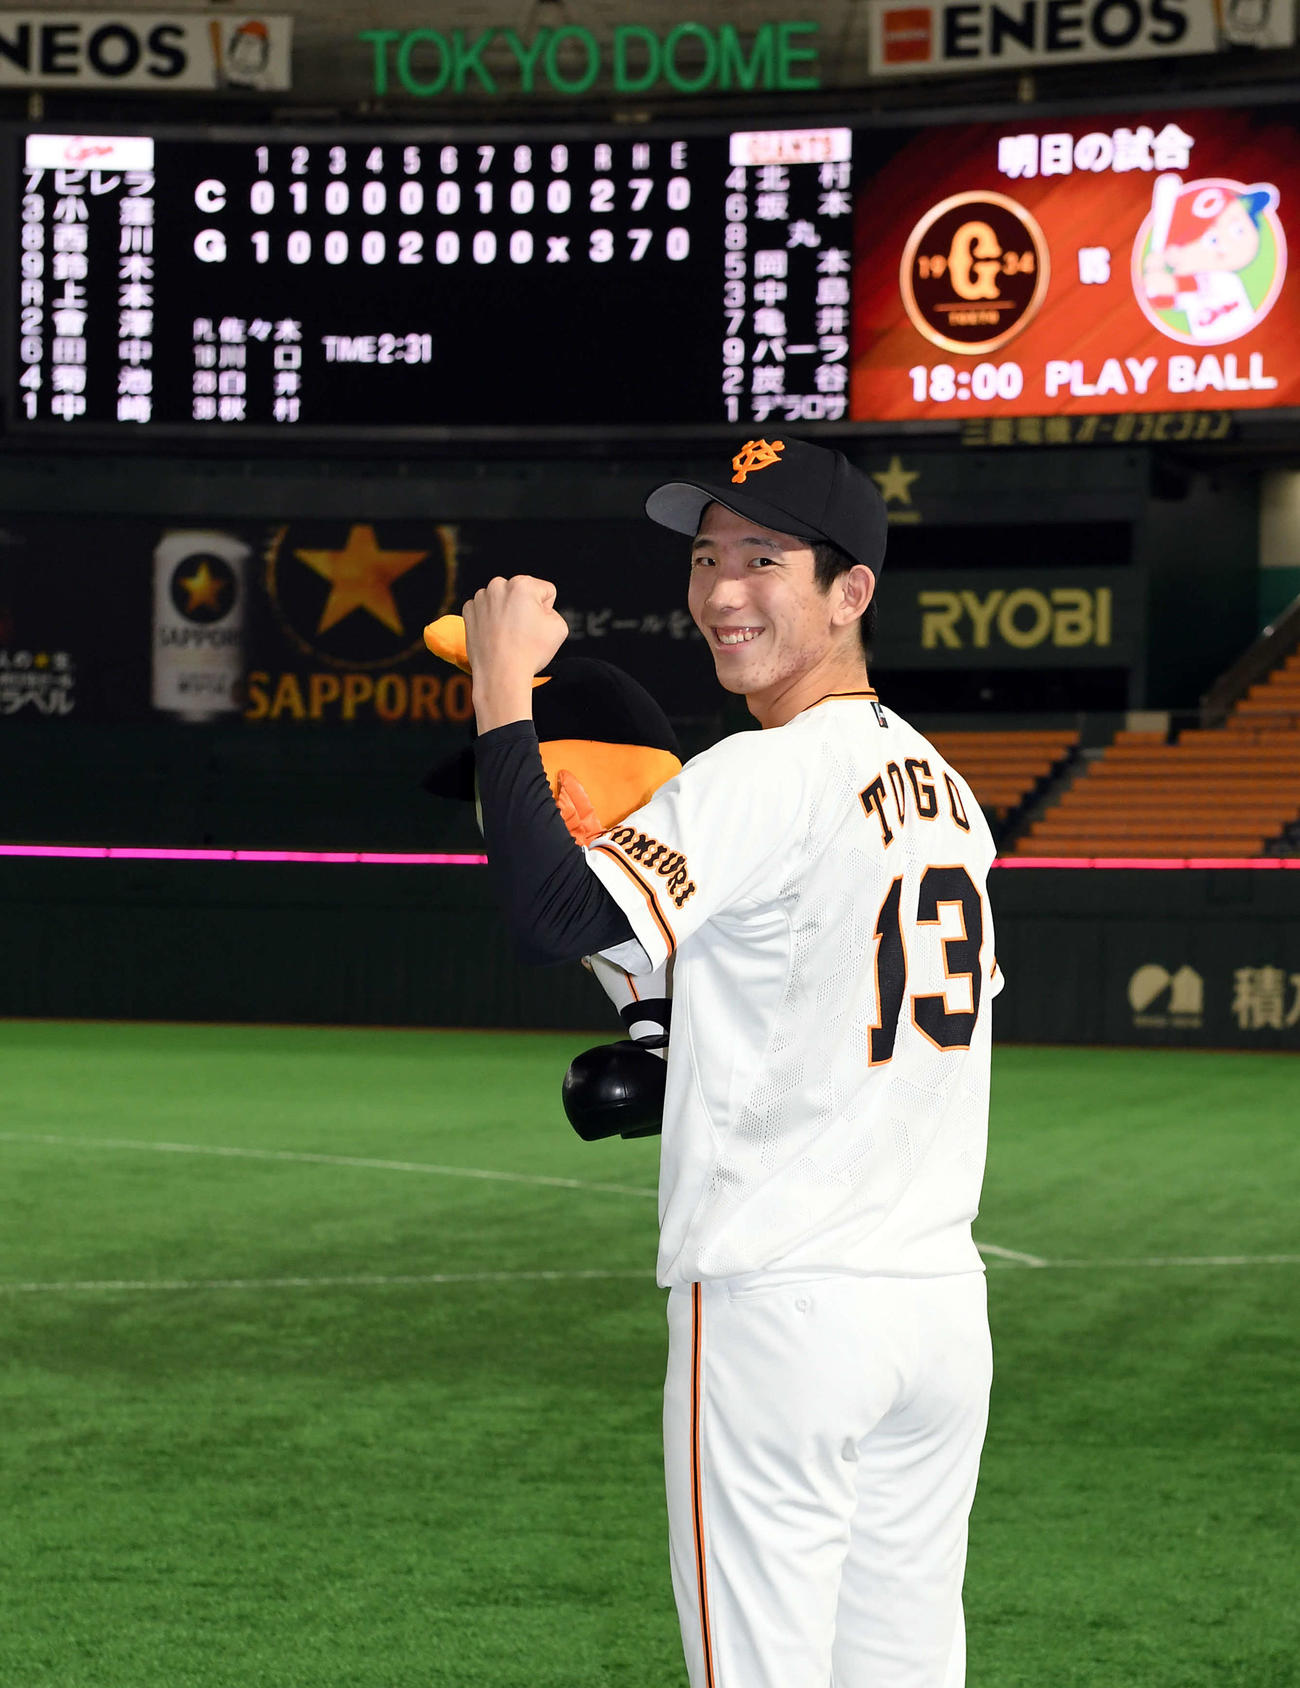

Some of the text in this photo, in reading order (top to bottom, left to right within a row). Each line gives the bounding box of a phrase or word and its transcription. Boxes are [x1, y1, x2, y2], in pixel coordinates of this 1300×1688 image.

[943, 0, 1188, 58] ENEOS
[358, 20, 820, 97] TOKYO DOME
[256, 147, 268, 172] 1
[292, 146, 309, 174] 2
[329, 147, 346, 174] 3
[366, 147, 383, 173] 4
[404, 146, 420, 174] 5
[440, 146, 457, 174] 6
[478, 146, 495, 172] 7
[514, 145, 532, 173] 8
[551, 145, 568, 173] 9
[671, 142, 686, 169] E
[998, 123, 1194, 178] 明日の試合
[725, 167, 747, 192] 4
[22, 193, 44, 222] 3
[195, 177, 690, 215] C 0 1 0 0 0 0 1 0 0 2 7 0
[725, 193, 747, 222] 6
[22, 223, 44, 251] 8
[194, 229, 226, 262] G
[251, 231, 269, 263] 1
[288, 231, 311, 264] 0
[325, 231, 348, 264] 0
[362, 231, 385, 264] 0
[399, 231, 423, 264] 2
[436, 231, 460, 264] 0
[473, 231, 496, 264] 0
[510, 230, 533, 264] 0
[589, 229, 614, 262] 3
[628, 229, 652, 261] 7
[667, 228, 689, 260] 0
[725, 222, 747, 250] 8
[21, 251, 44, 279] 9
[724, 250, 746, 280] 5
[948, 221, 1004, 301] G
[21, 279, 43, 307] R
[724, 280, 746, 308] 3
[21, 307, 43, 336] 2
[724, 309, 746, 336] 7
[21, 336, 43, 364] 6
[322, 333, 433, 364] TIME 2:31
[723, 337, 745, 365] 9
[20, 364, 43, 392] 4
[722, 366, 745, 394] 2
[909, 351, 1279, 403] 18:00 PLAY BALL
[22, 391, 37, 420] 1
[725, 396, 739, 423] 1
[918, 587, 1112, 650] RYOBI
[246, 671, 473, 723] SAPPORO
[858, 756, 972, 851] TOGO
[604, 825, 697, 909] OMIURI
[867, 864, 985, 1068] 13
